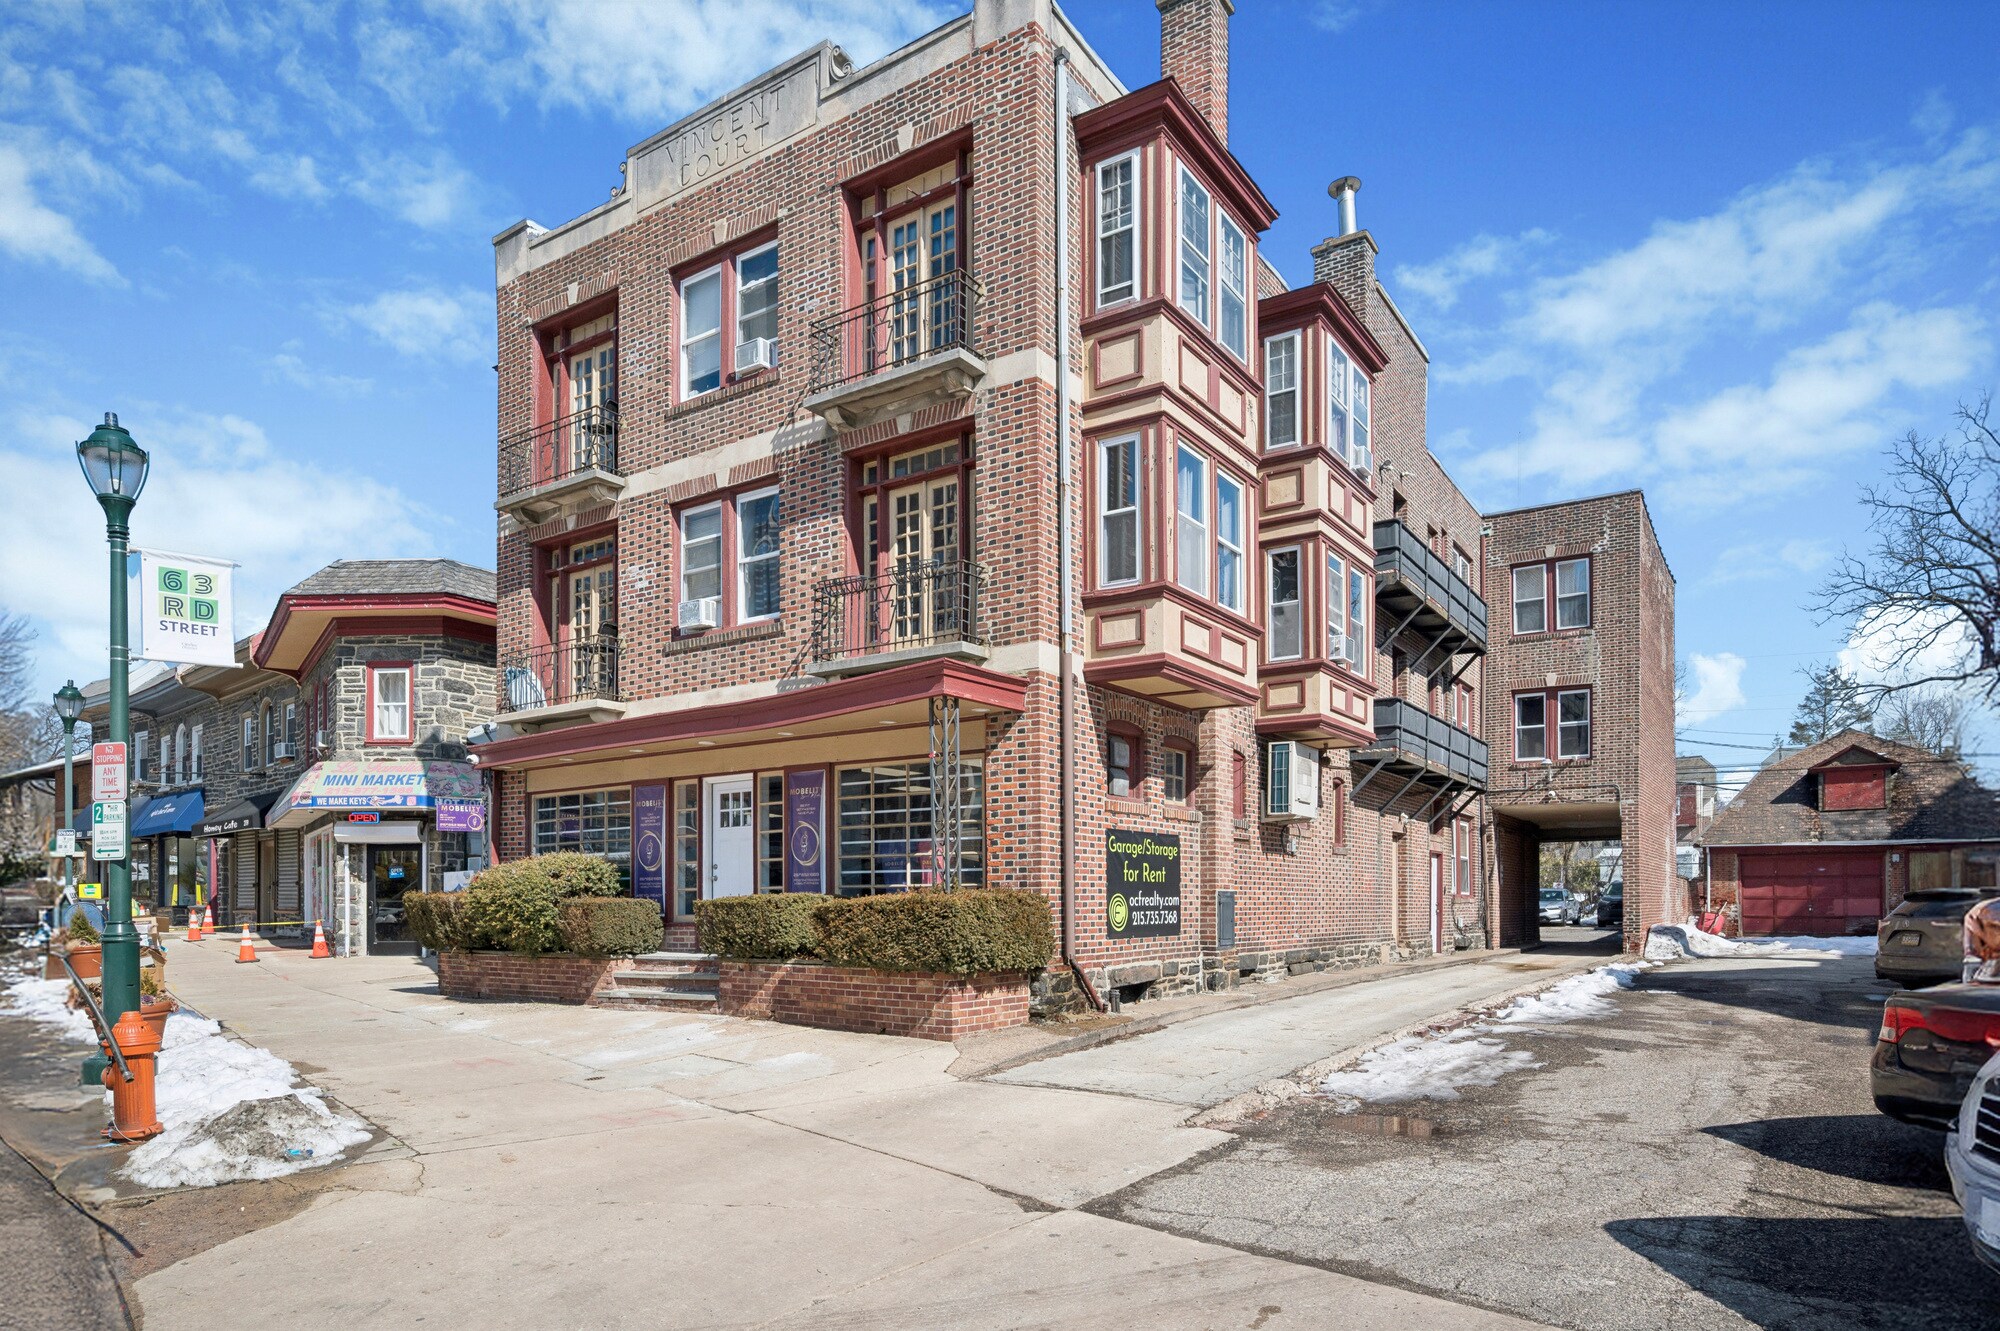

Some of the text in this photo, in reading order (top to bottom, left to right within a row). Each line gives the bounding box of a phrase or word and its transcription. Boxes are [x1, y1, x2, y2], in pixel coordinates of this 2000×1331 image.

[666, 85, 785, 163] VINCENT
[680, 121, 770, 187] COURT
[160, 620, 218, 636] STREET
[96, 754, 123, 763] STOPPING
[103, 767, 117, 776] ANY
[102, 777, 117, 787] TIME
[323, 774, 425, 786] MINI MARKET
[317, 796, 367, 806] WE MAKE KEYS
[95, 805, 102, 821] 2
[104, 813, 123, 821] PARKING
[349, 813, 377, 822] OPEN
[1108, 835, 1178, 860] Garage/Storage
[1123, 861, 1166, 882] for Rent
[1129, 890, 1179, 909] ocfrealty.com
[1132, 911, 1178, 925] 215.735.7368
